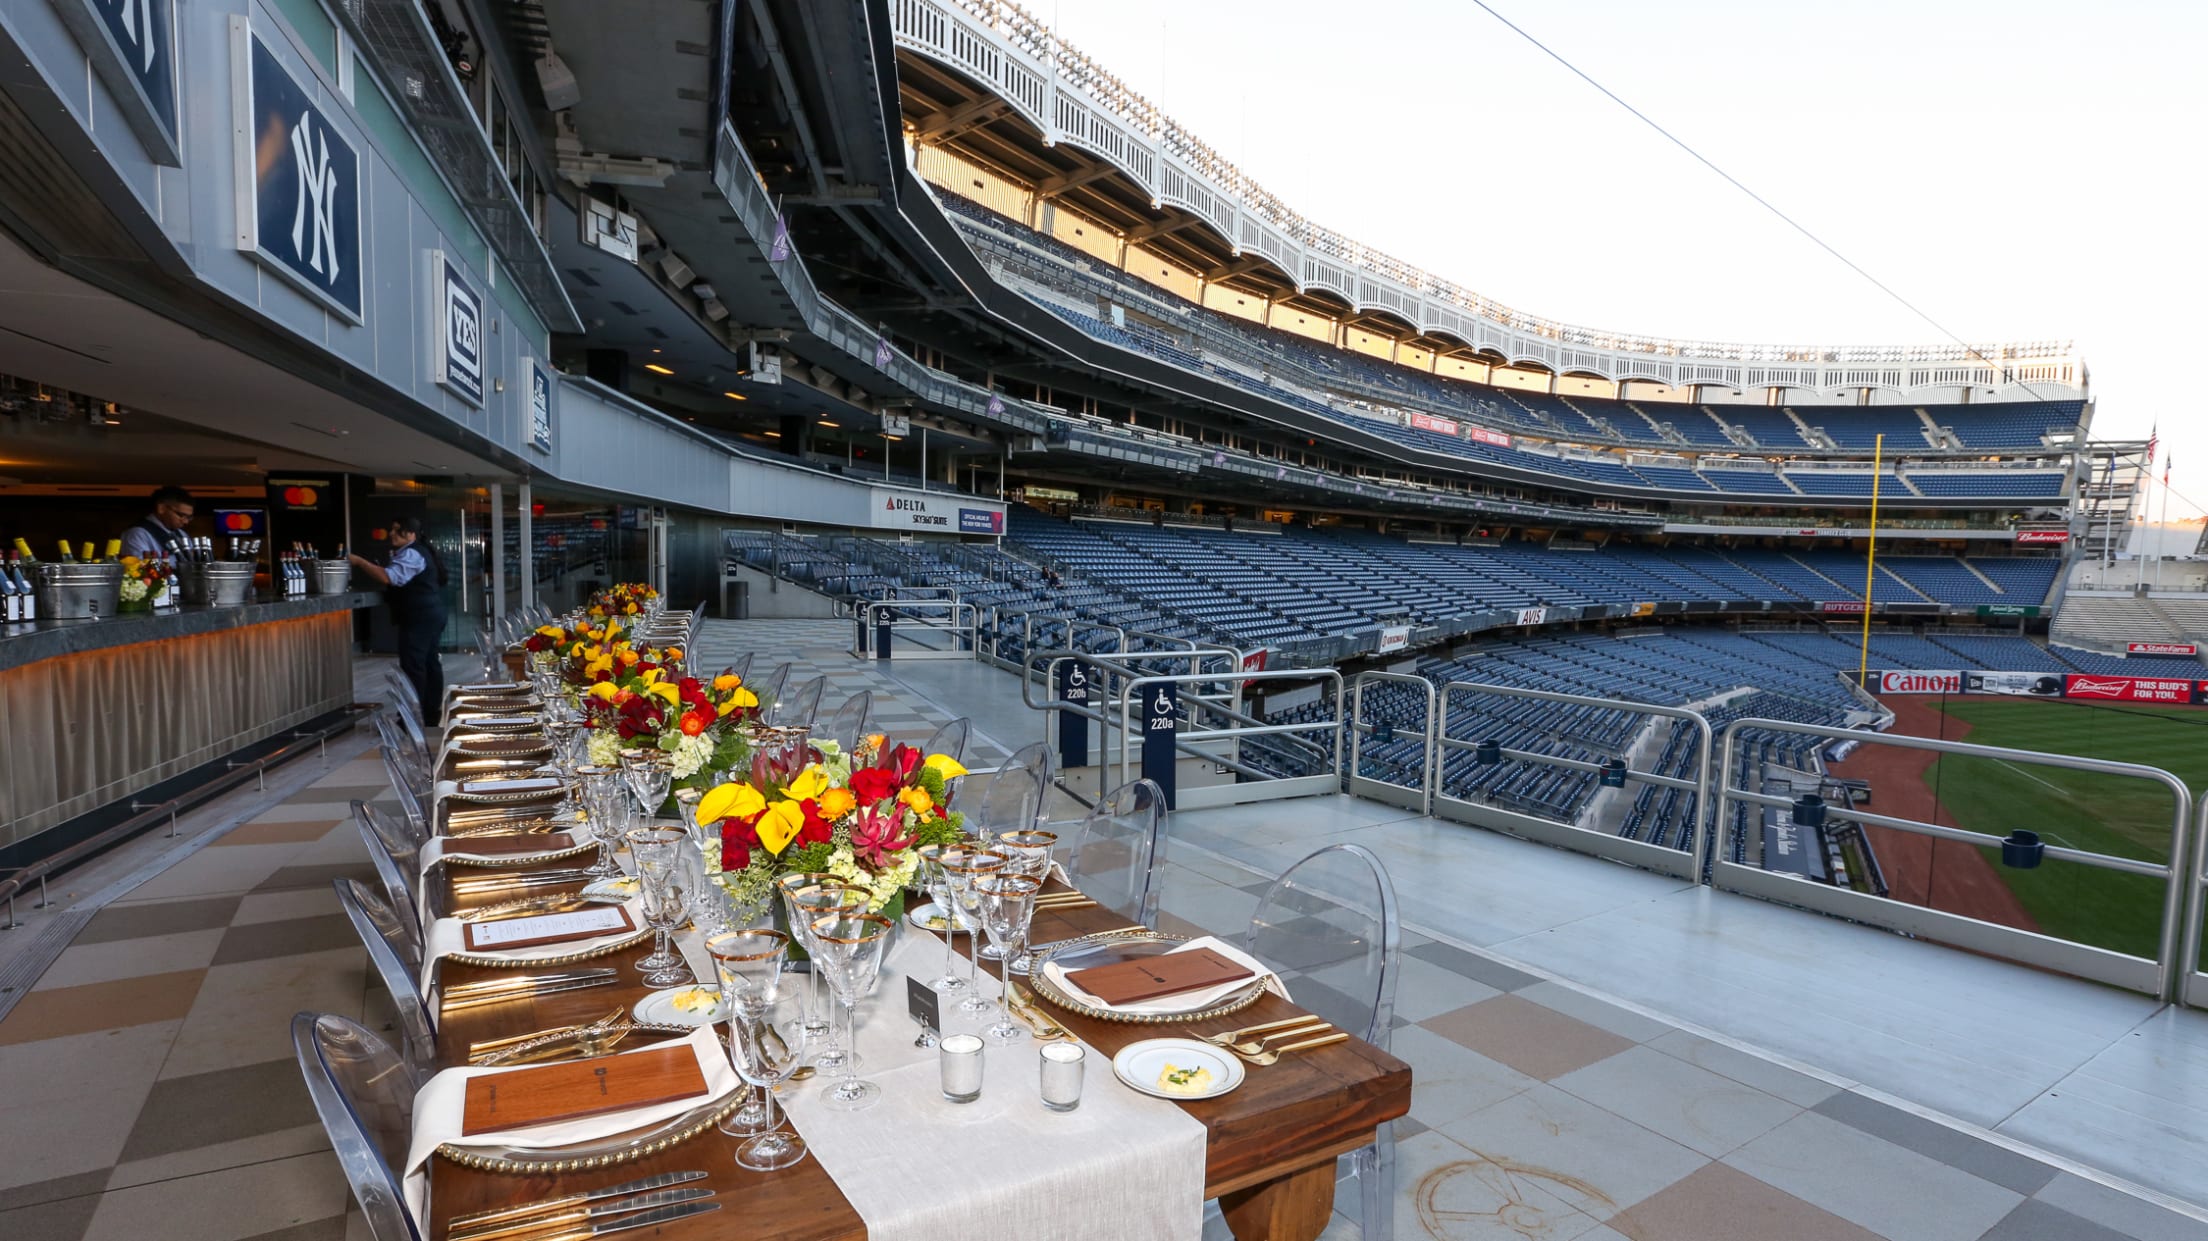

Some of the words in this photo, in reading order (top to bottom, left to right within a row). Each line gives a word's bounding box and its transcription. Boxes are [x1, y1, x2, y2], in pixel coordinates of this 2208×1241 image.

[453, 303, 477, 356] YES
[896, 499, 925, 512] DELTA
[2018, 532, 2069, 541] Budweiser
[1825, 603, 1870, 611] RUTGER
[1522, 609, 1541, 624] AVIS
[1882, 672, 1959, 692] Canon
[2075, 681, 2123, 691] Budweiser
[2134, 681, 2157, 690] THIS
[2158, 682, 2188, 691] BUD'S
[1067, 688, 1087, 699] 220b
[2133, 690, 2154, 699] FOR
[2155, 691, 2178, 700] YOU.
[1151, 717, 1174, 729] 220a
